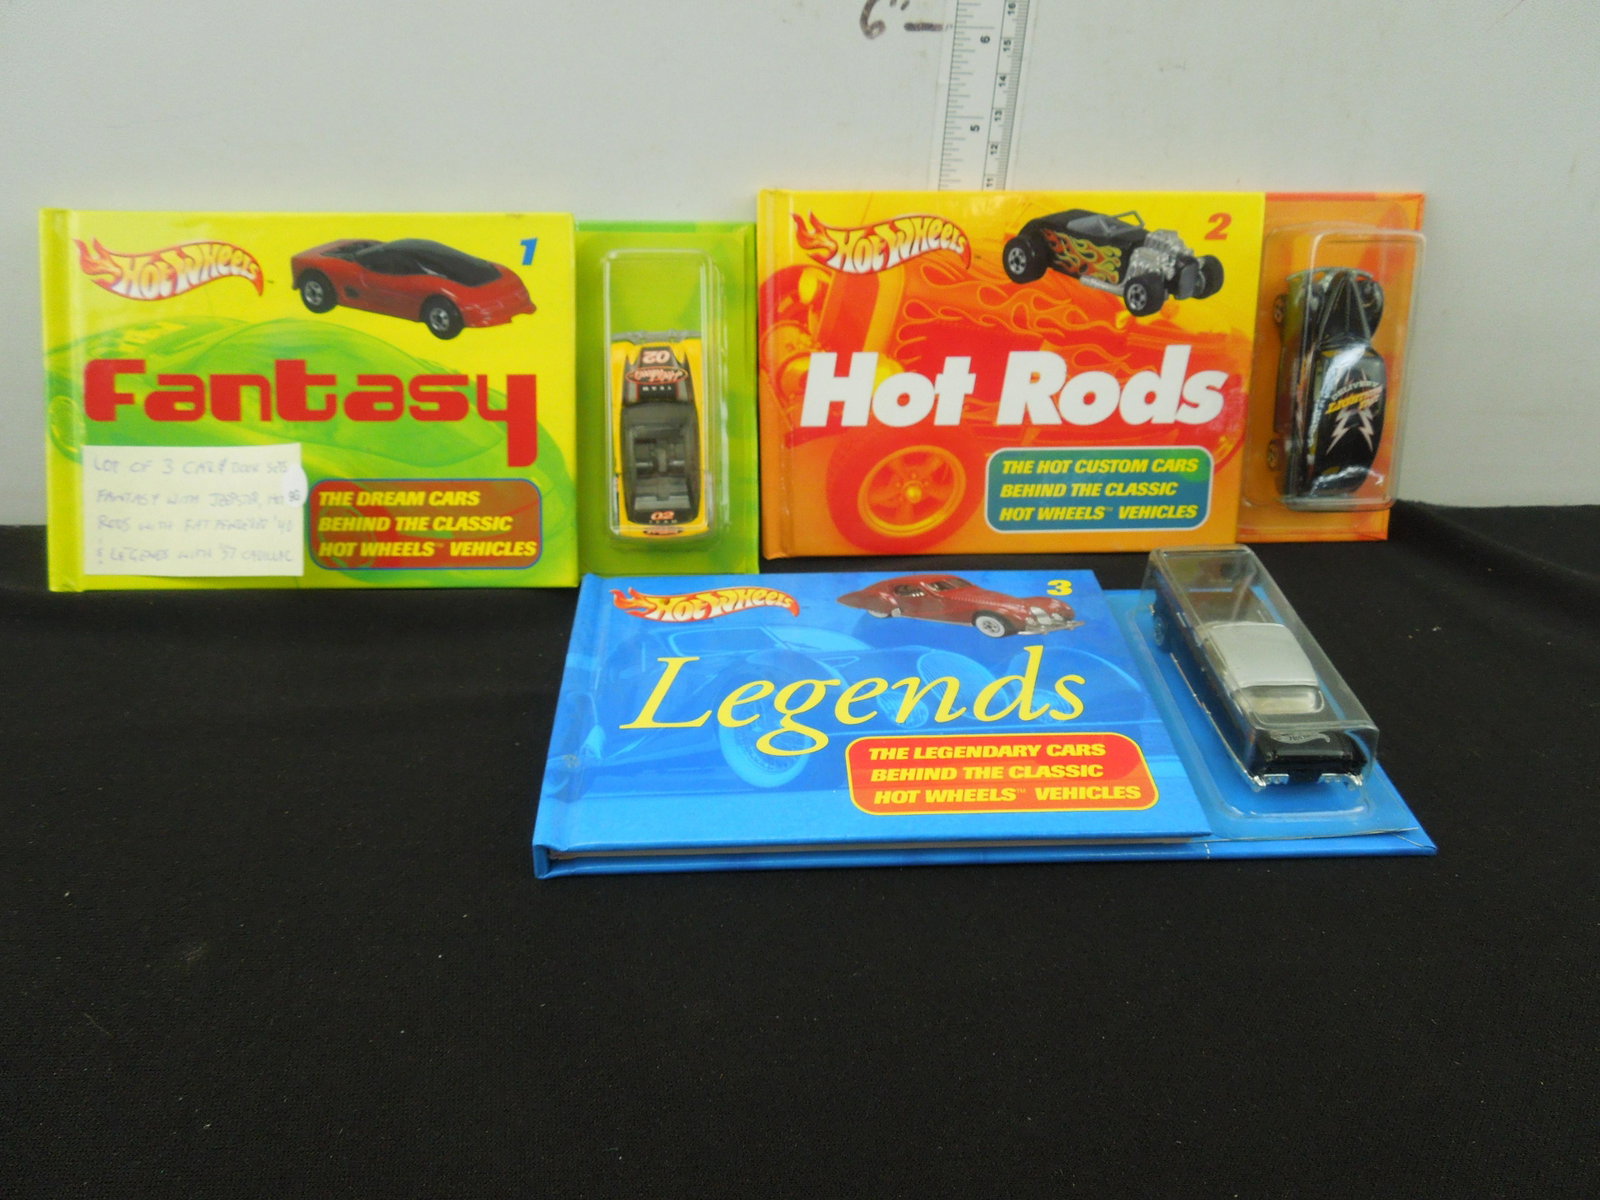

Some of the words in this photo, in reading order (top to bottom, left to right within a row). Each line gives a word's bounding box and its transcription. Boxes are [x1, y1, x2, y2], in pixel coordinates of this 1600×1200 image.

[1008, 3, 1016, 15] 16
[980, 36, 990, 44] 6
[1003, 40, 1011, 52] 15
[999, 76, 1007, 87] 14
[994, 110, 1002, 122] 13
[990, 144, 998, 155] 12
[1205, 213, 1232, 240] 2
[520, 238, 538, 266] 1
[800, 352, 976, 427] Hot
[996, 345, 1228, 426] Rods
[84, 359, 538, 467] Fantasy
[94, 455, 120, 474] LOT
[129, 458, 153, 473] OF
[161, 458, 174, 474] 3
[1002, 460, 1035, 474] THE
[1036, 460, 1073, 474] HOT
[1074, 459, 1150, 473] CUSTOM
[1151, 458, 1199, 472] CARS
[319, 491, 354, 506] THE
[356, 491, 424, 506] DREAM
[429, 490, 481, 506] CARS
[1000, 483, 1066, 498] BEHIND
[1071, 483, 1103, 497] THE
[1105, 482, 1178, 496] CLASSIC
[999, 507, 1035, 521] HOT
[1118, 505, 1199, 519] VEHICLES
[318, 517, 391, 531] BEHIND
[395, 517, 430, 531] THE
[433, 516, 513, 531] CLASSIC
[318, 542, 357, 557] HOT
[450, 541, 538, 556] VEHICLES
[1047, 580, 1072, 596] 3
[619, 645, 1086, 756] Legends
[869, 747, 910, 761] THE
[913, 745, 1042, 759] LEGENDARY
[1046, 744, 1107, 757] CARS
[871, 767, 958, 782] BEHIND
[963, 766, 1005, 780] THE
[1008, 764, 1104, 779] CLASSIC
[874, 790, 921, 804] HOT
[1034, 786, 1142, 801] VEHICLES
